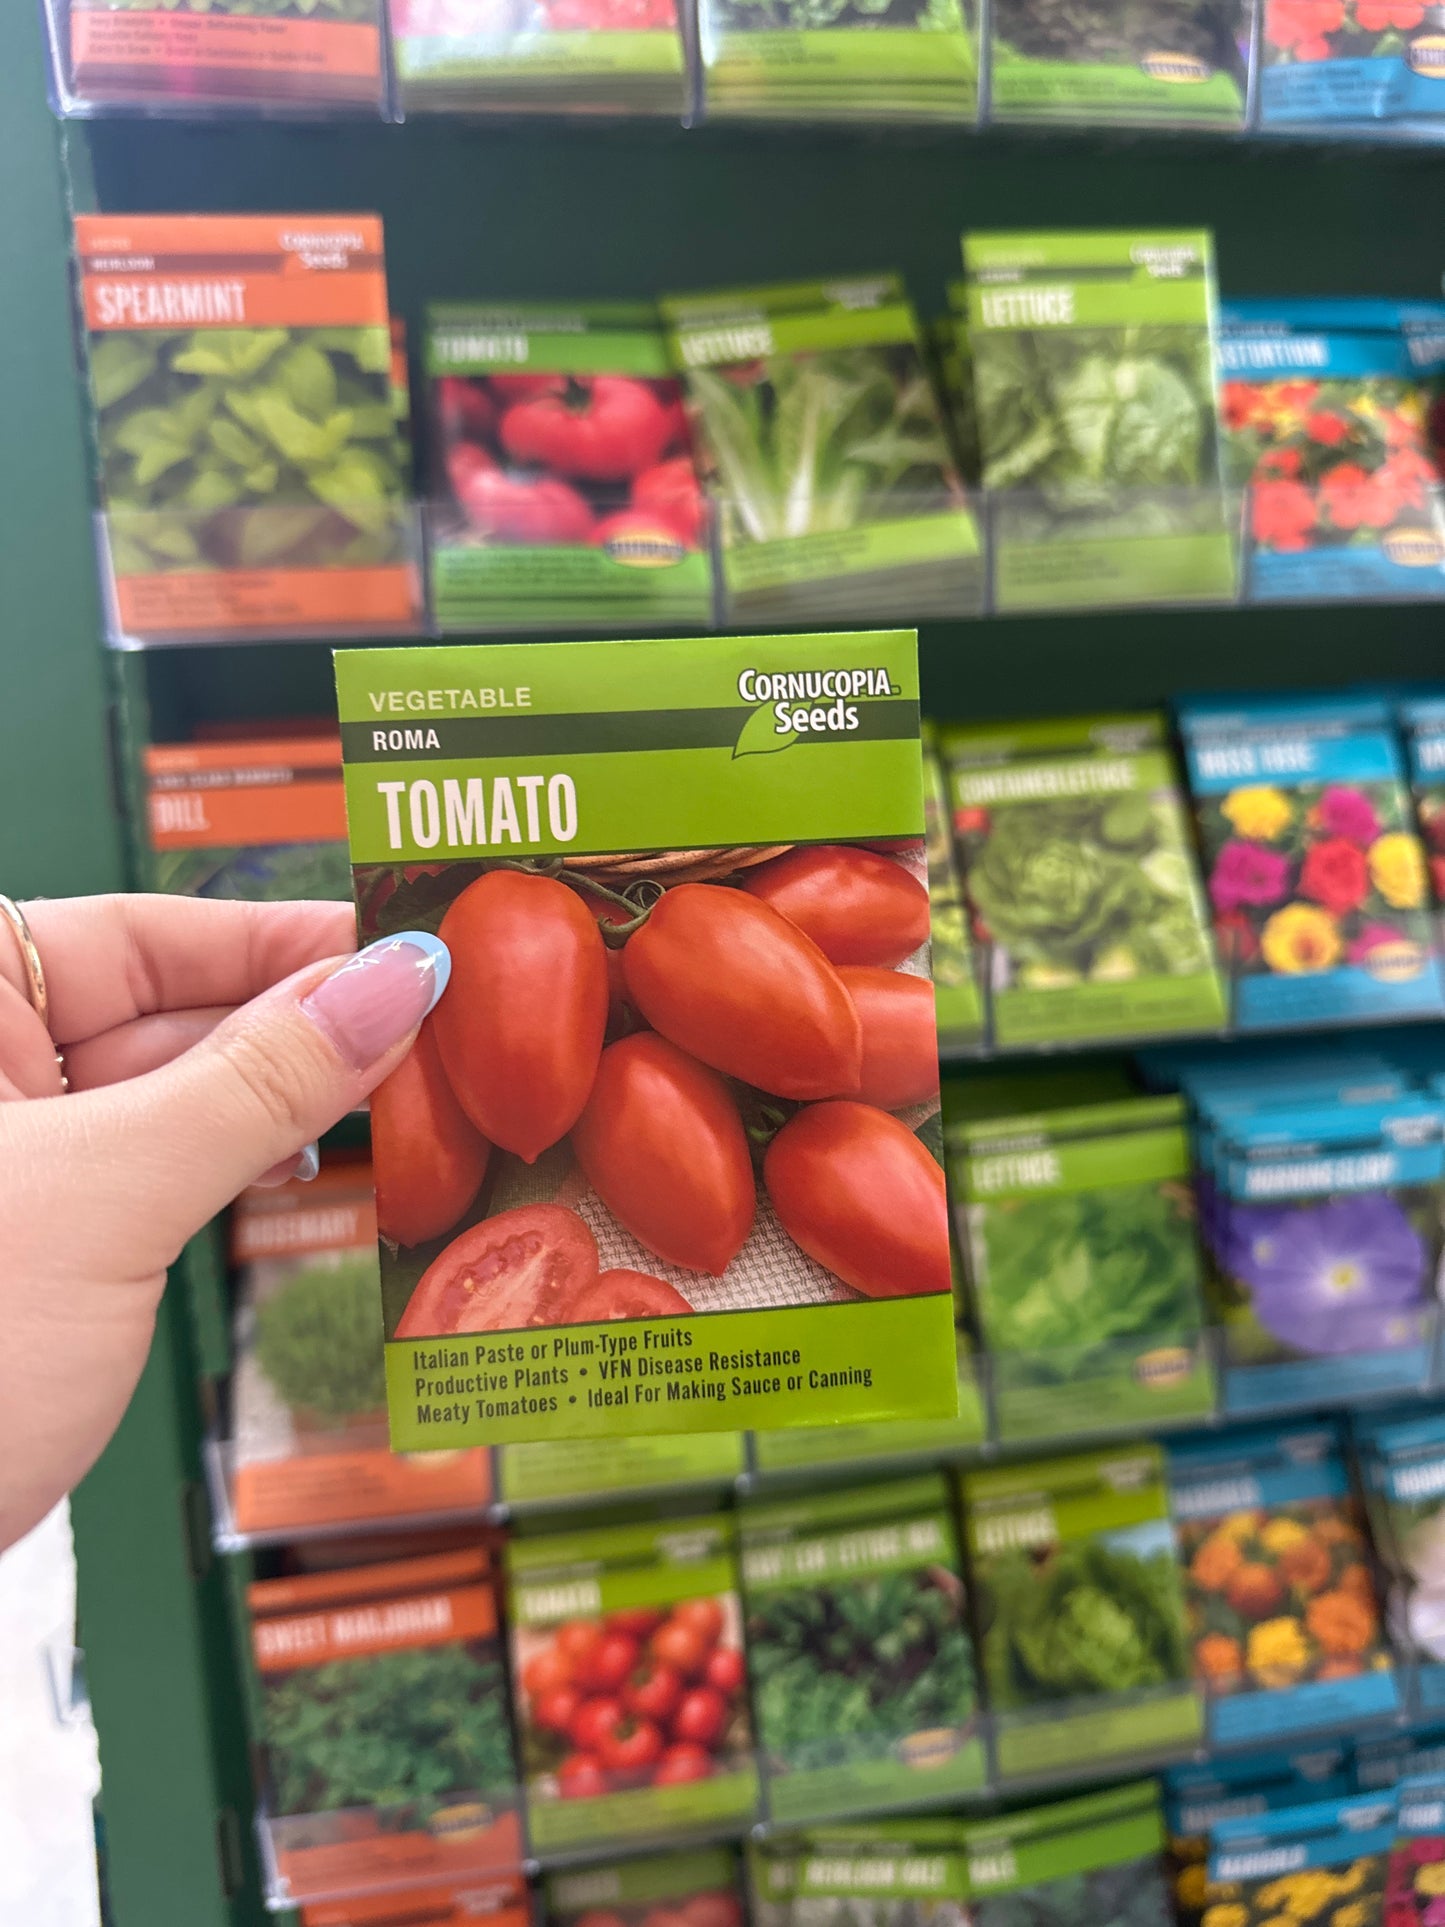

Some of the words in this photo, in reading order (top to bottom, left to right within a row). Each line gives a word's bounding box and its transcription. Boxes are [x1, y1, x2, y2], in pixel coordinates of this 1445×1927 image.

[97, 280, 247, 324] SPEARMINT
[368, 686, 533, 713] VEGETABLE
[738, 667, 892, 702] CORNUCOPIA
[773, 698, 860, 734] Seeds
[372, 728, 442, 751] ROMA
[154, 792, 209, 832] DILL
[376, 773, 578, 850] TOMATO
[413, 1350, 469, 1371] Italian
[475, 1344, 525, 1365] Paste
[531, 1343, 548, 1360] or
[554, 1334, 638, 1357] Plum-Type
[643, 1328, 693, 1350] Fruits
[415, 1374, 508, 1397] Productive
[514, 1366, 569, 1389] Plants
[599, 1358, 632, 1379] VFN
[638, 1356, 703, 1377] Disease
[709, 1348, 801, 1371] Resistance
[417, 1403, 470, 1425] Meaty
[476, 1394, 558, 1418] Tomatoes
[588, 1385, 629, 1408] Ideal
[635, 1383, 661, 1403] For
[667, 1378, 727, 1402] Making
[732, 1374, 781, 1396] Sauce
[787, 1373, 802, 1391] or
[808, 1366, 873, 1390] Canning
